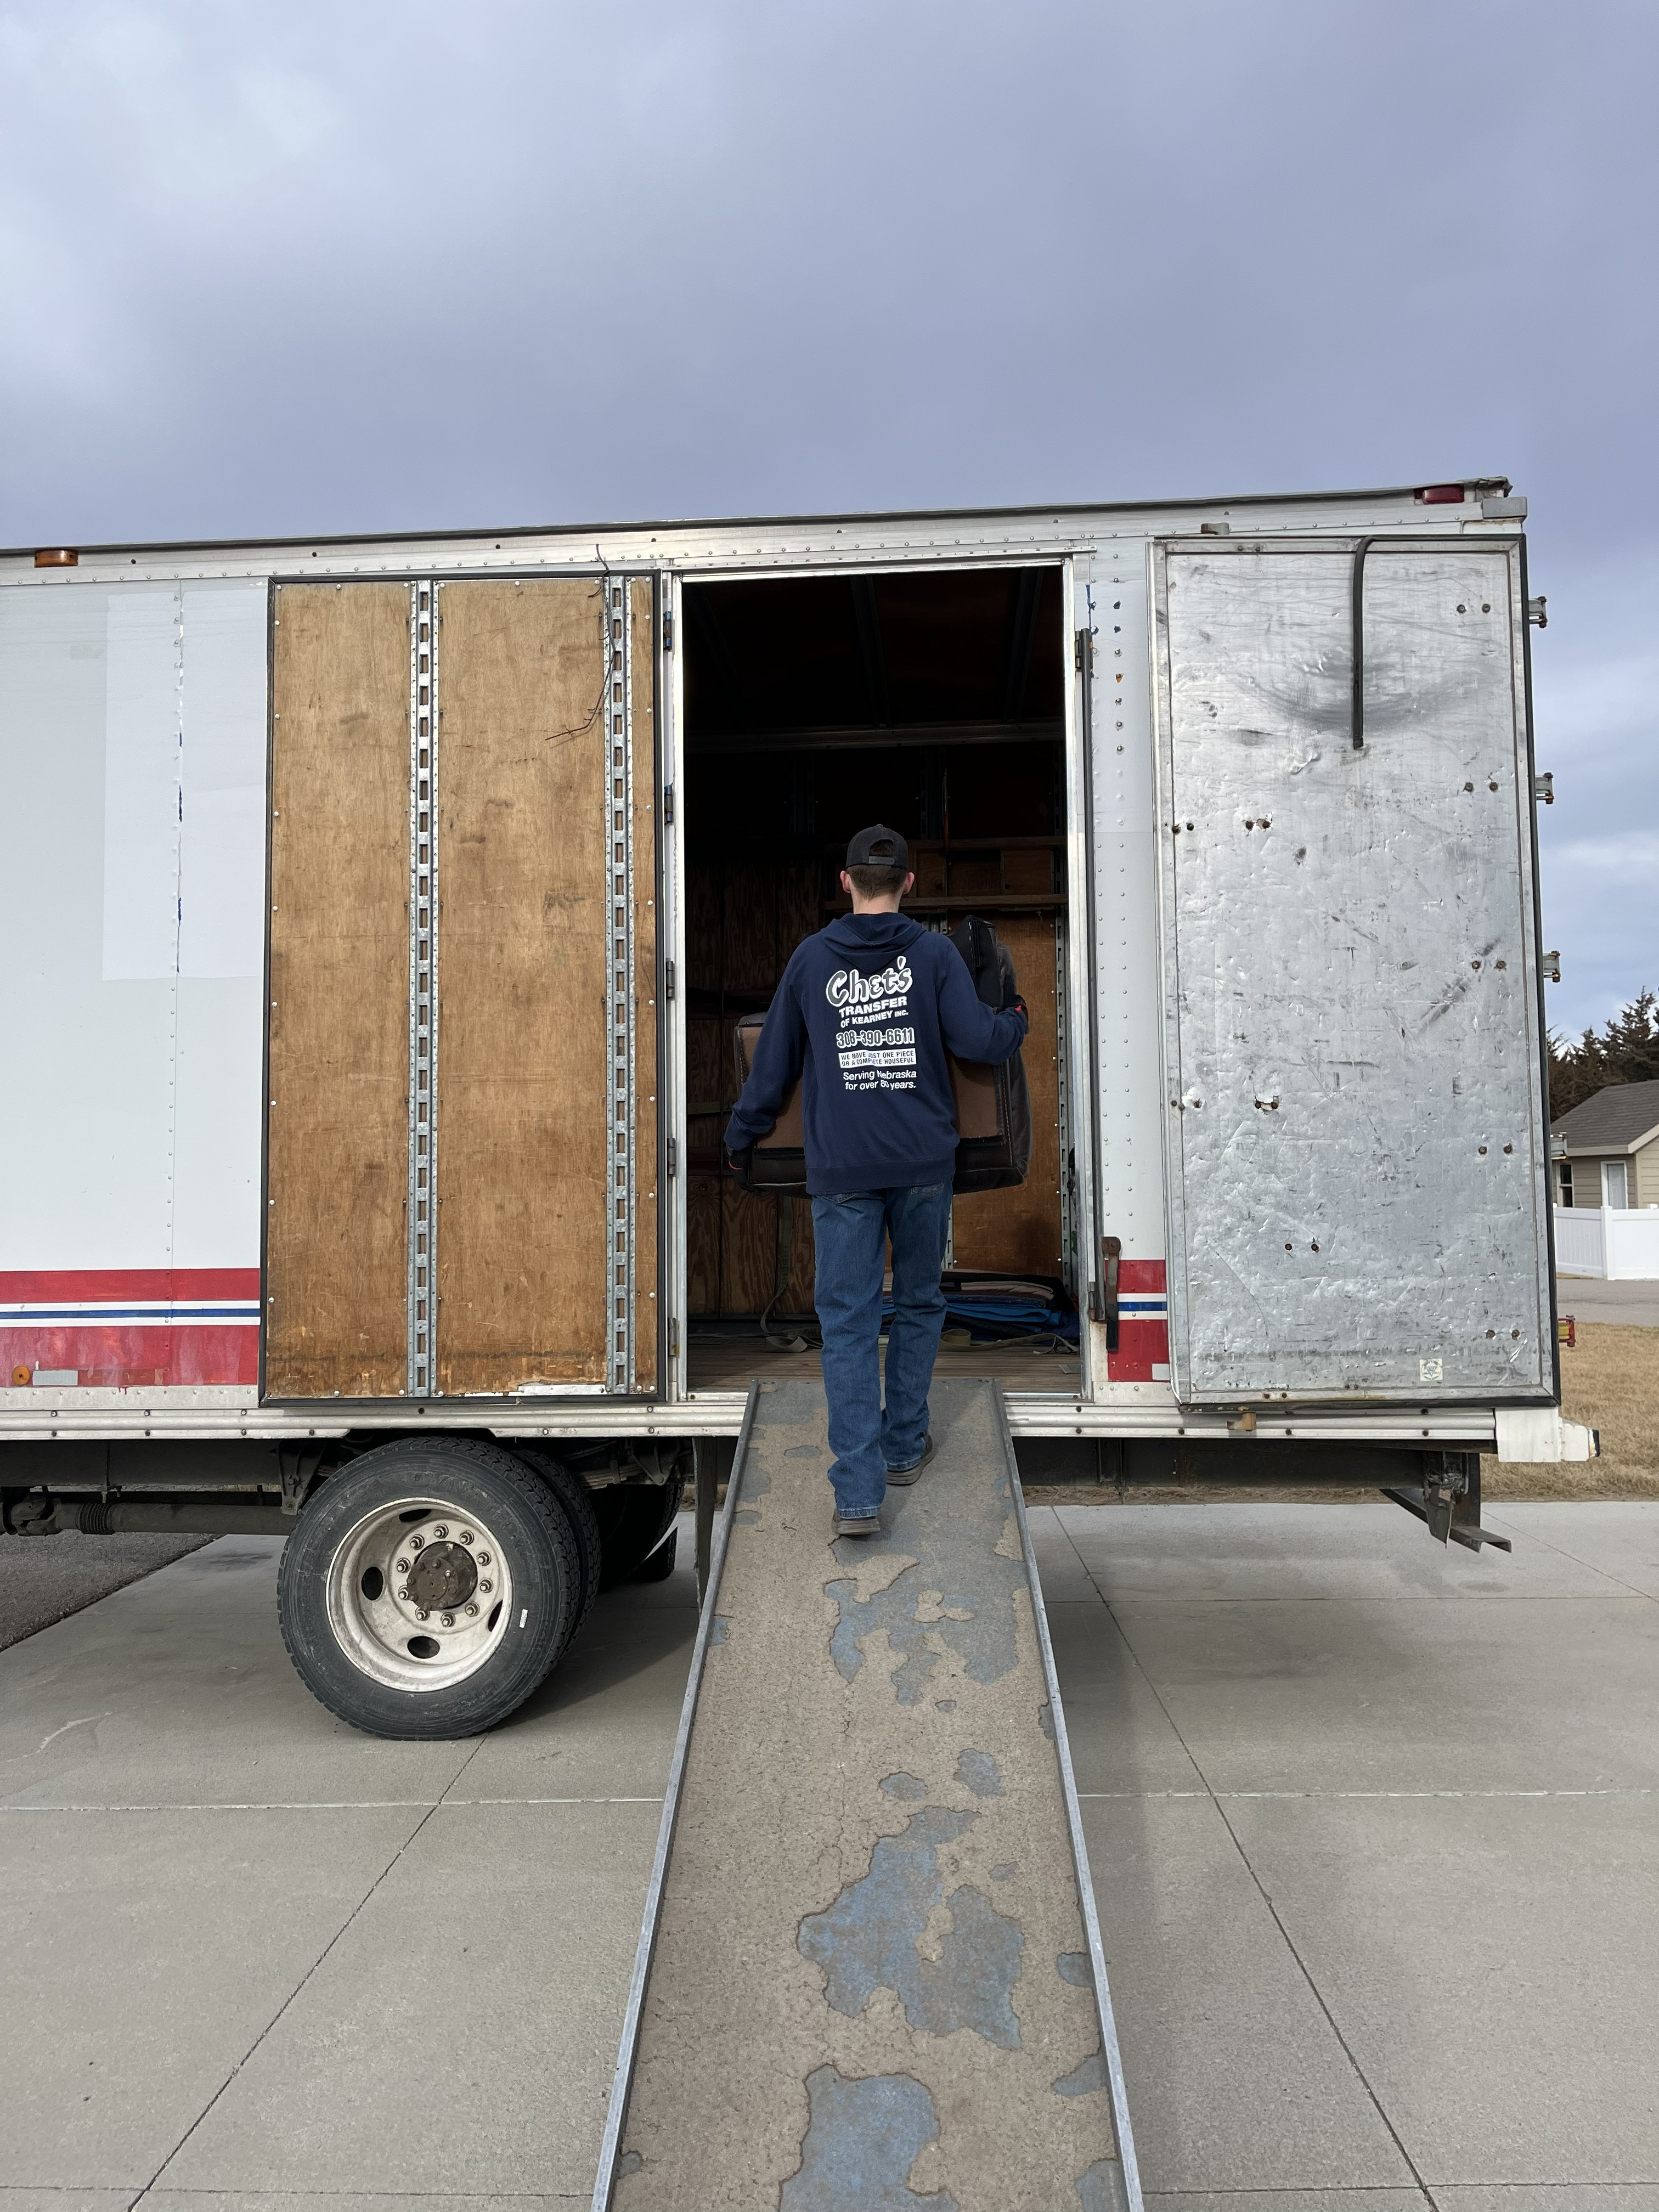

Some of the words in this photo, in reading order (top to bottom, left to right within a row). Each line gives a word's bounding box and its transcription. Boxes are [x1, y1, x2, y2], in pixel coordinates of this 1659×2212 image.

[826, 956, 913, 1007] Chet's
[839, 996, 907, 1018] TRANSFER
[840, 1018, 850, 1028] OF
[852, 1010, 893, 1024] KEARNEY
[836, 1027, 915, 1048] 308-390-6611
[843, 1071, 874, 1080] Serving
[877, 1070, 917, 1079] Nebraska
[845, 1082, 857, 1090] for
[860, 1081, 878, 1090] over
[890, 1081, 916, 1090] years.
